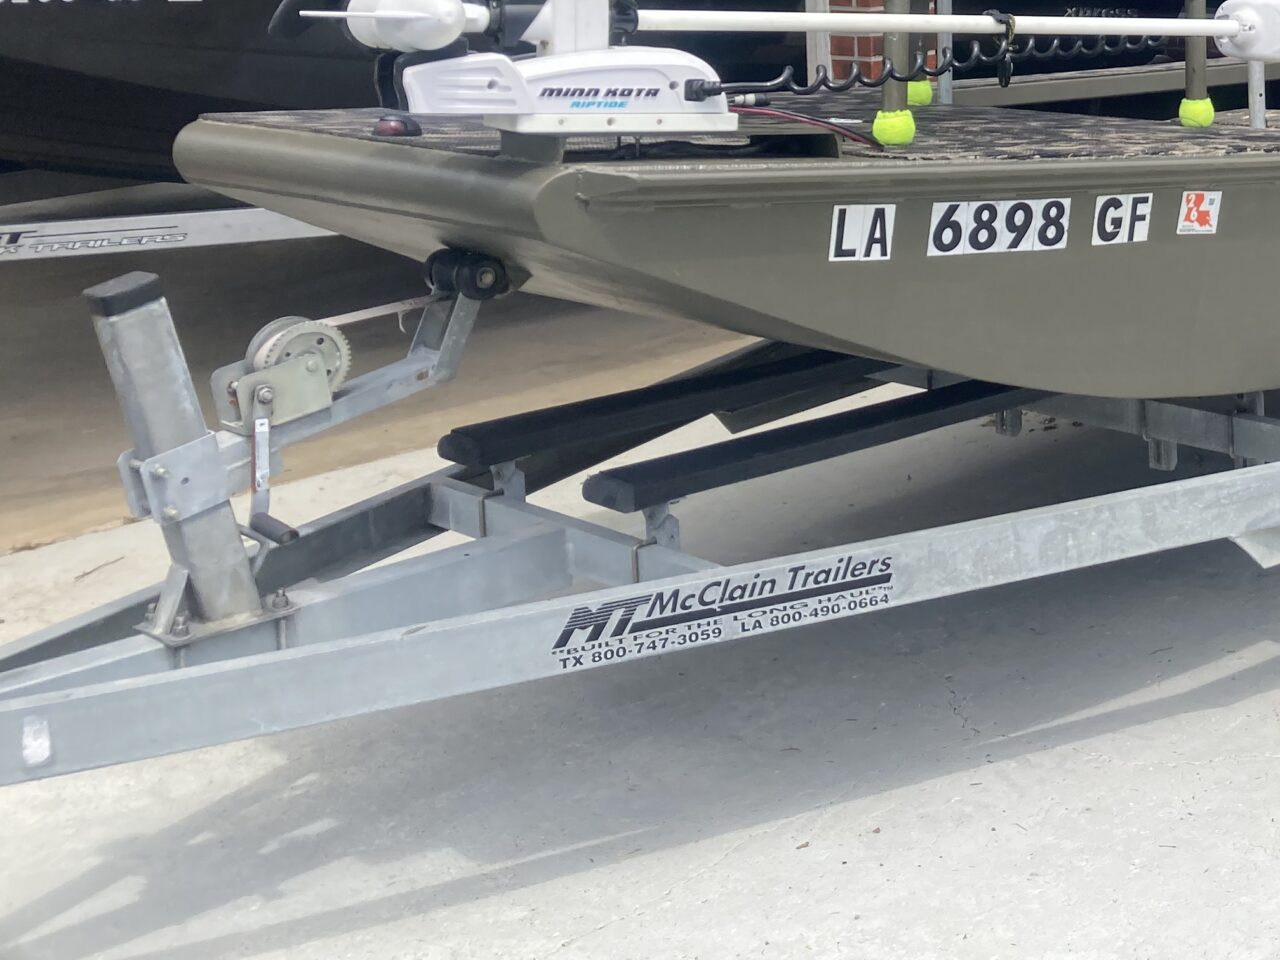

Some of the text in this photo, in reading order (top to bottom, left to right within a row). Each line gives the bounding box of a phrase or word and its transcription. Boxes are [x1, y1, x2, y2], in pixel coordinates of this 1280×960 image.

[539, 87, 660, 97] MINN KOTA
[570, 100, 629, 109] RIPTIDE
[28, 232, 189, 253] TRAILERS
[833, 195, 1150, 259] LA 6898 GF
[646, 555, 893, 618] McClain Trailers
[559, 593, 890, 670] TX 800-747-3059 LA 800-490-0664
[632, 627, 678, 642] FOR
[684, 618, 723, 631] THE
[732, 601, 809, 622] LONG
